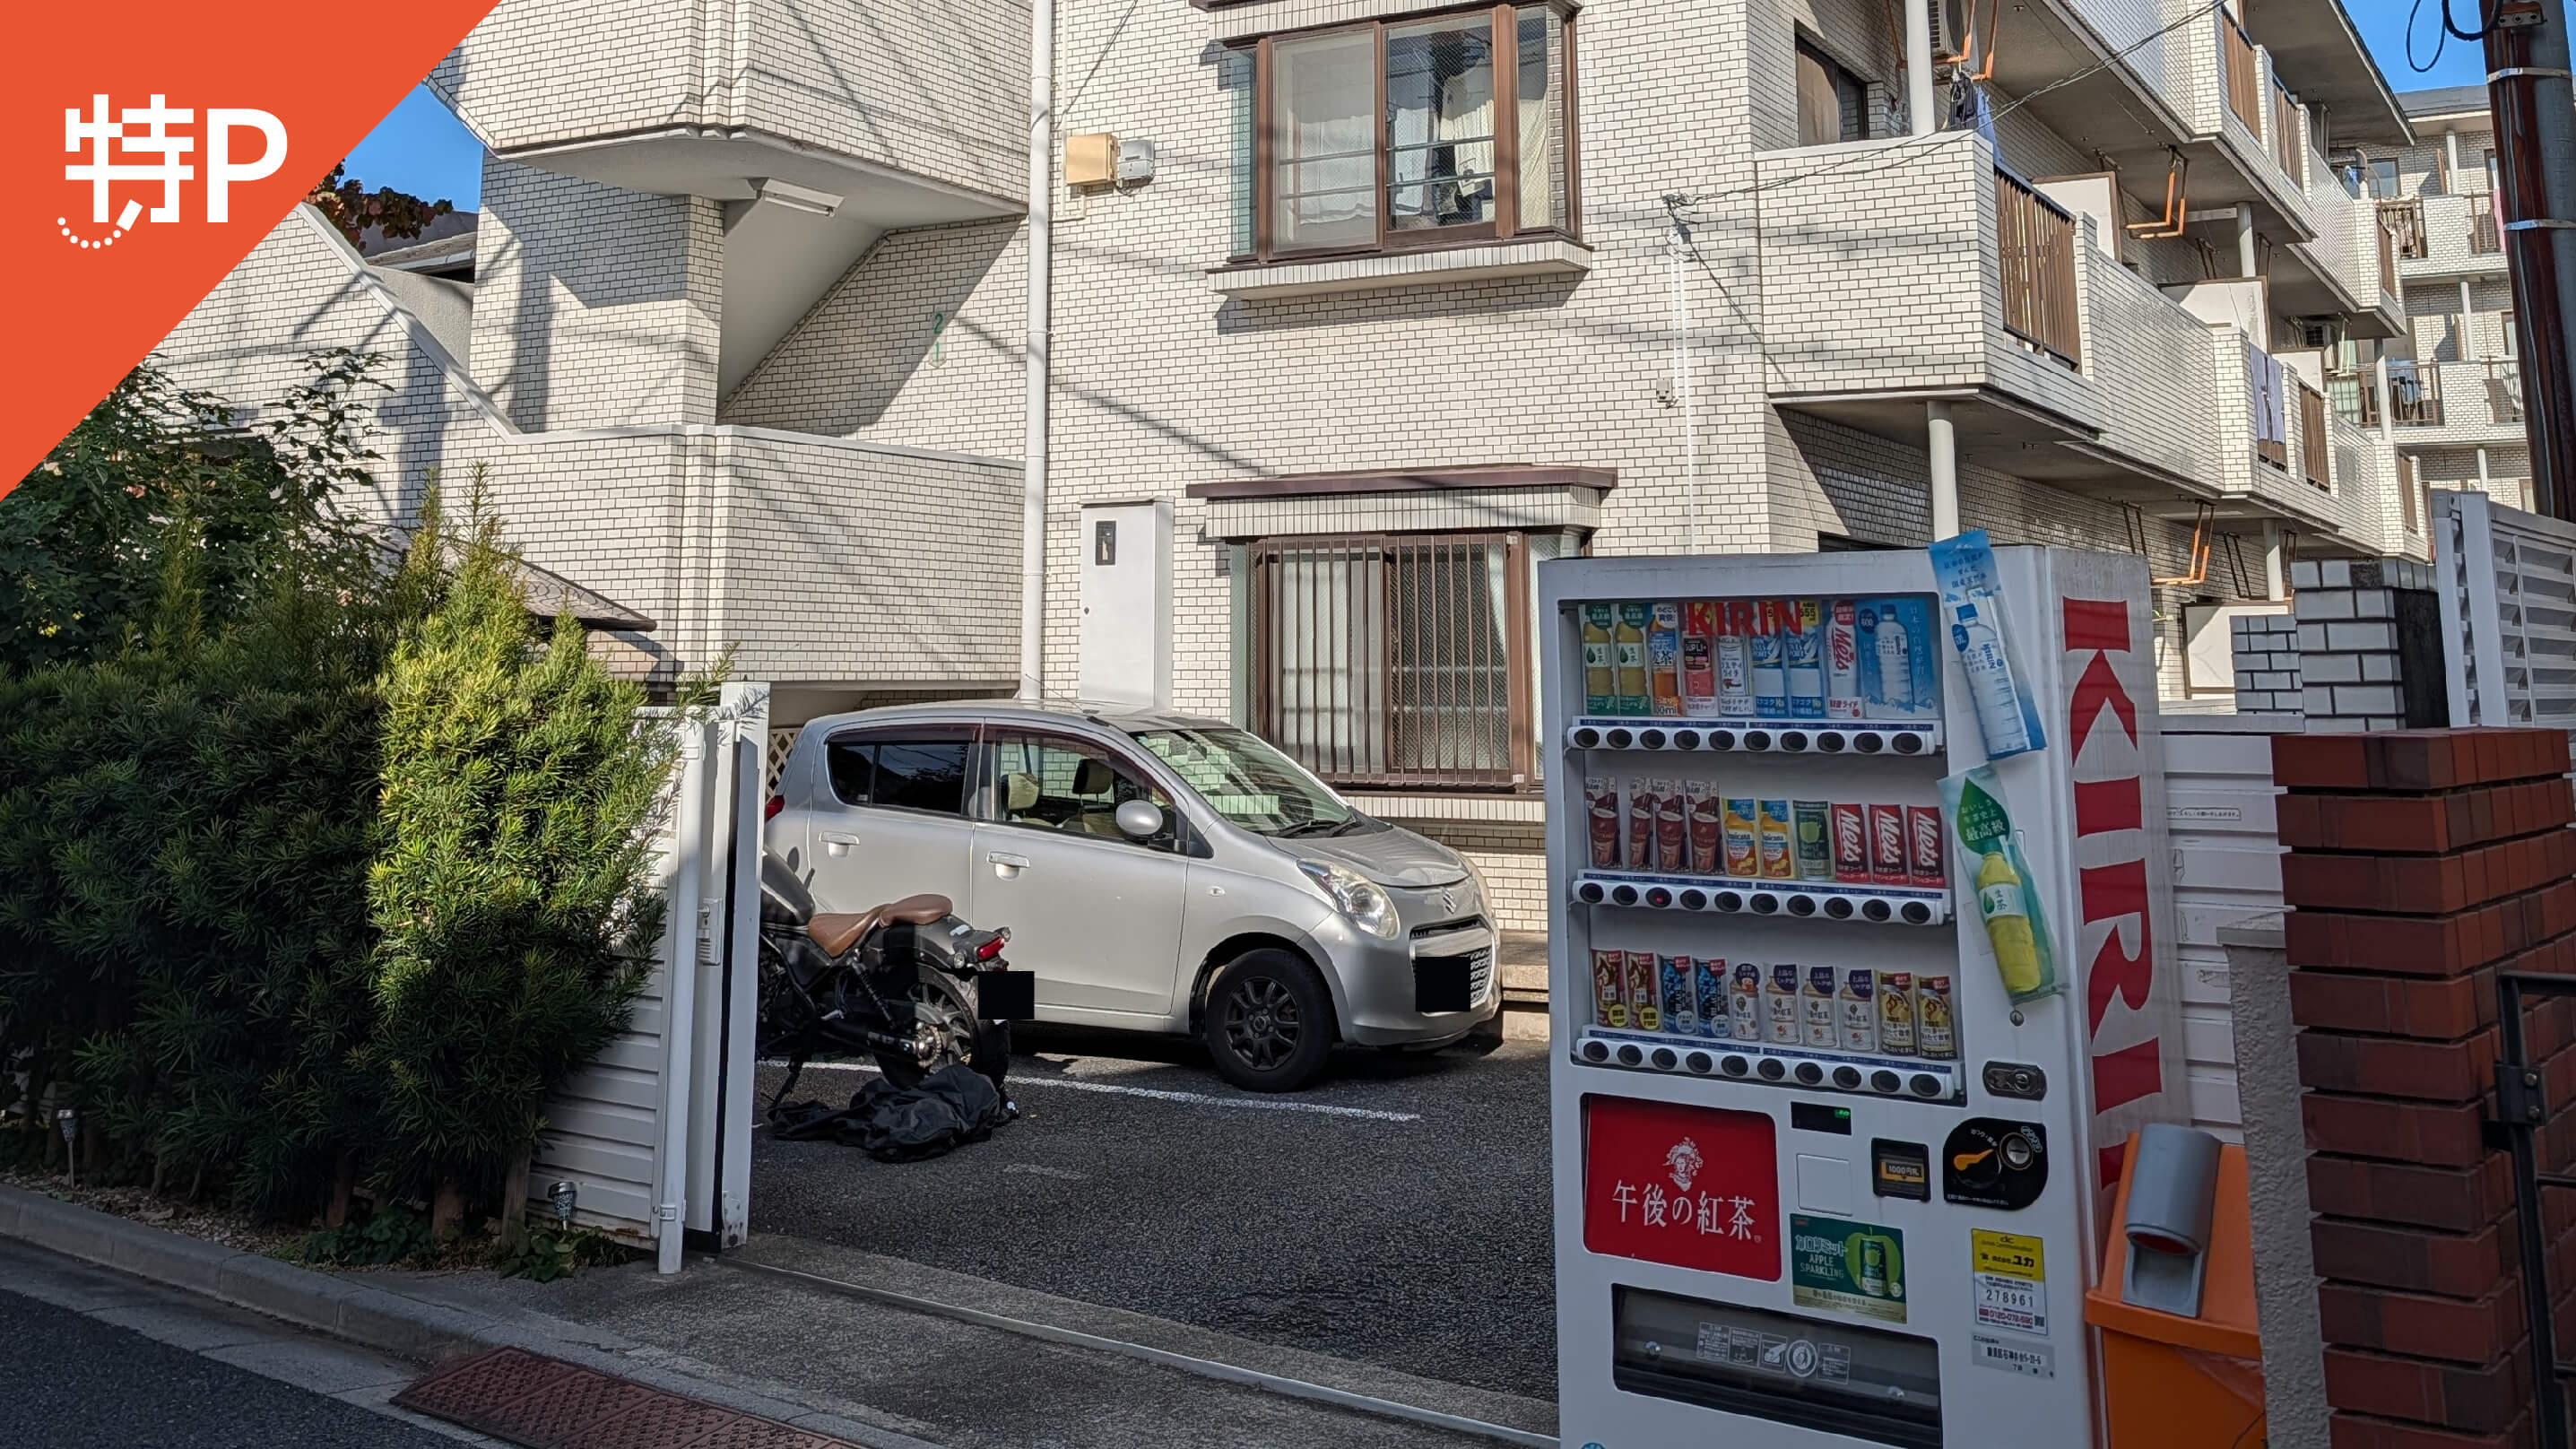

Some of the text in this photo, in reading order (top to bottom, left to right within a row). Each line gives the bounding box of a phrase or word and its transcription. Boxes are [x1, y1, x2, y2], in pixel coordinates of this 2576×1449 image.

[1687, 601, 1802, 638] KIRIN
[1840, 808, 1862, 863] Mets
[1878, 809, 1902, 864] Mets
[1916, 811, 1939, 867] Mets
[1965, 819, 2006, 841] 最高級
[1994, 889, 2008, 911] 生茶
[2063, 596, 2162, 1190] KIRI
[1887, 1165, 1920, 1177] 1000円札
[1612, 1178, 1756, 1241] 午後の紅茶
[1795, 1234, 1849, 1257] カロリミット
[1800, 1262, 1844, 1278] SPARKLING
[1808, 1254, 1834, 1267] APPLE
[1986, 1288, 2034, 1307] 278961
